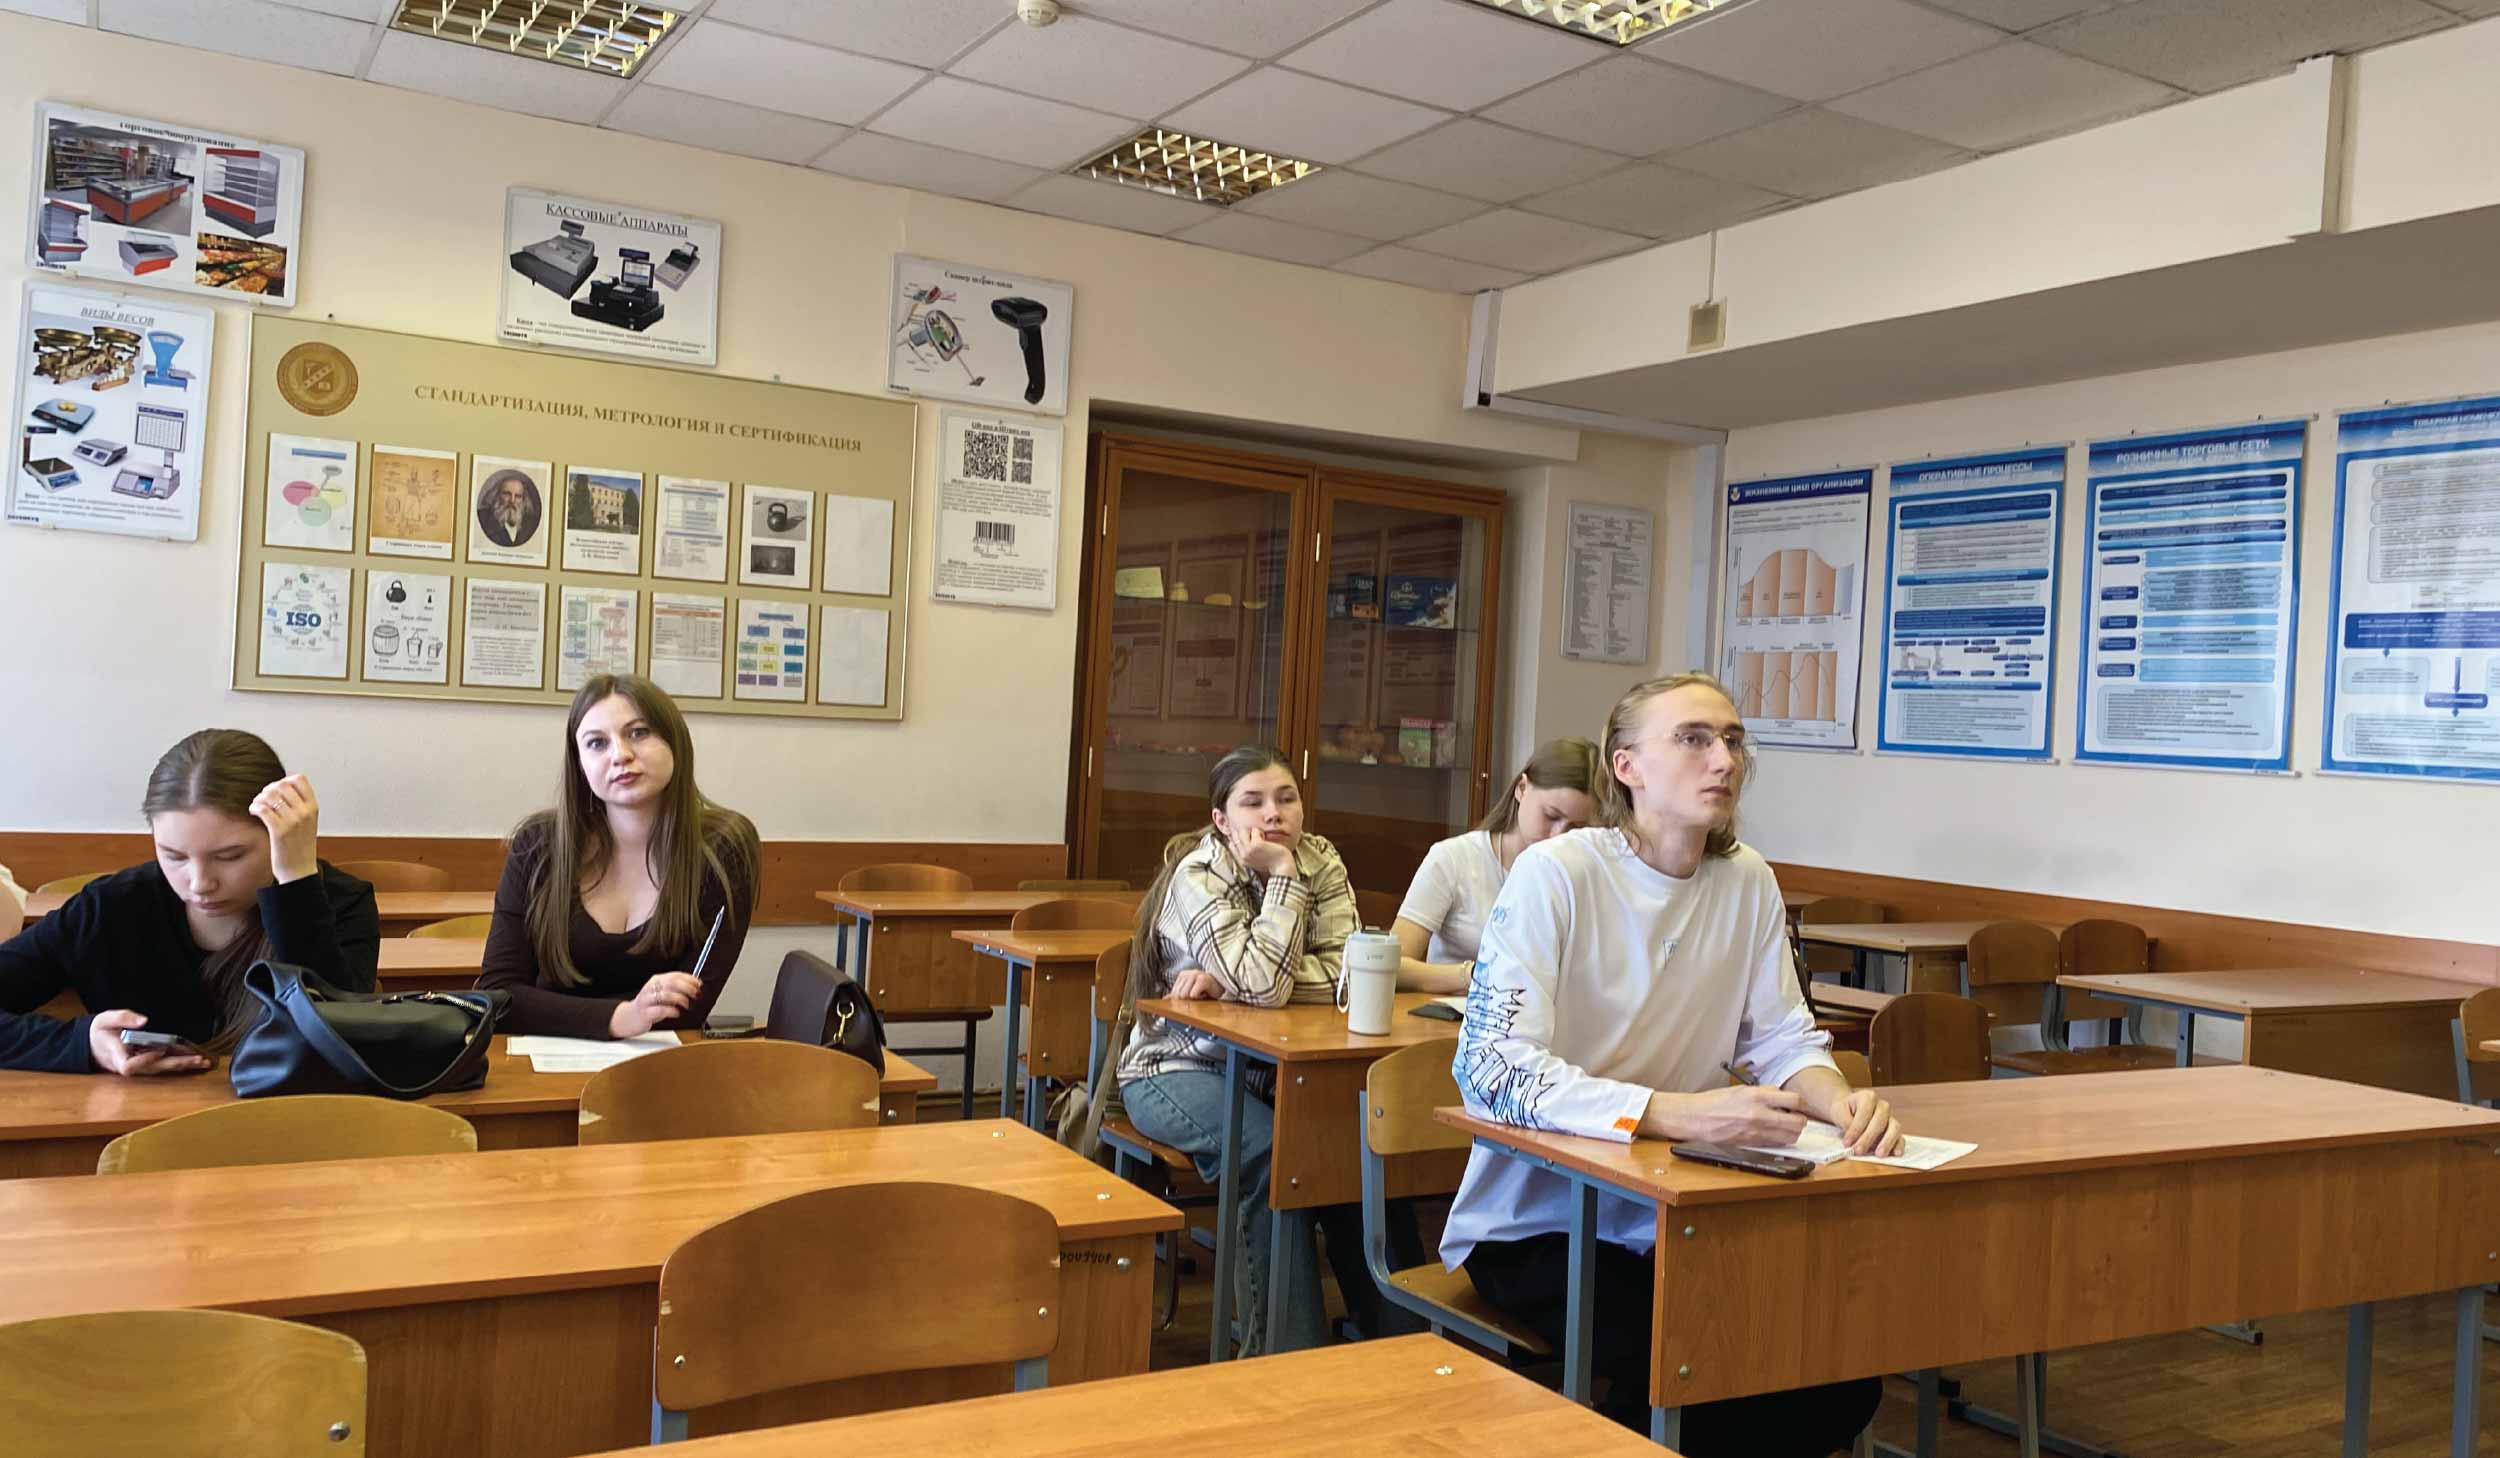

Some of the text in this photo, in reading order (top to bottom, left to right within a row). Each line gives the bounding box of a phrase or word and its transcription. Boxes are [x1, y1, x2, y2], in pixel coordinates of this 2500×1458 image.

[546, 203, 688, 237] КАССОВЫЕ АППАРАТЫ
[80, 307, 154, 326] ВИДЫ ВЕСОВ
[414, 385, 861, 452] СТАНДАРТИЗАЦИЯ, МЕТРОЛОГИЯ И СЕРТИФИКАЦИЯ
[2116, 448, 2179, 464] РОЗНИЧНЫЕ
[2183, 441, 2239, 457] ТОРГОВЫЕ
[2241, 438, 2270, 449] СЕТИ
[1918, 462, 2033, 481] ОПЕРАТИВНЫЕ ПРОЦЕССЫ
[1791, 484, 1810, 493] ЦИКЛ
[1811, 478, 1864, 490] ОРГАНИЗАЦИИ
[286, 611, 322, 628] ISO
